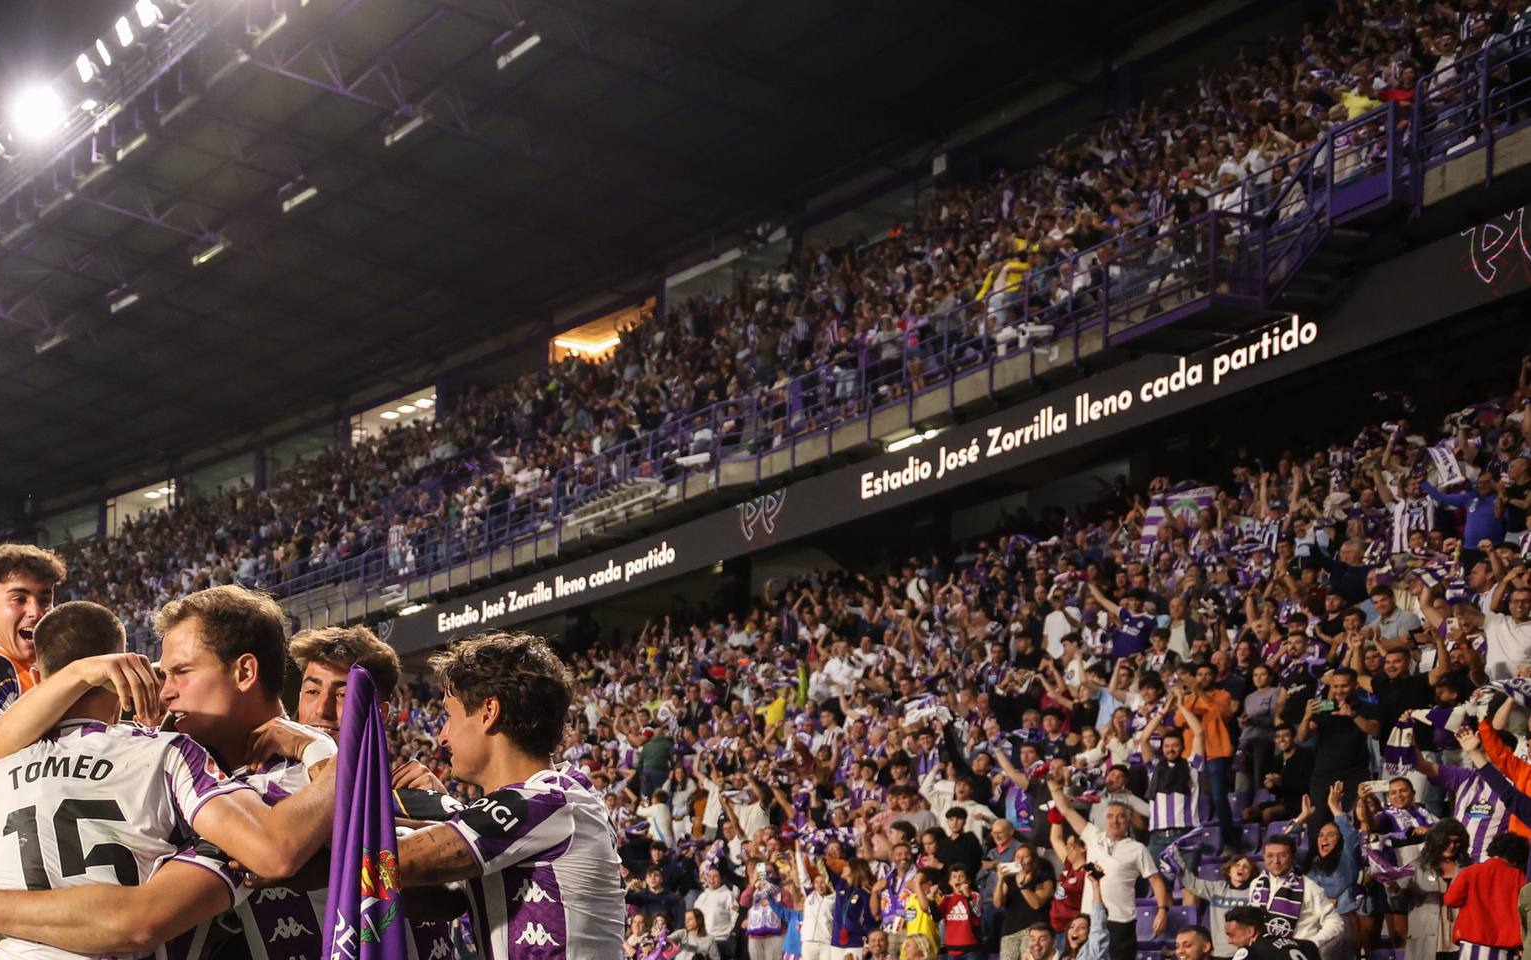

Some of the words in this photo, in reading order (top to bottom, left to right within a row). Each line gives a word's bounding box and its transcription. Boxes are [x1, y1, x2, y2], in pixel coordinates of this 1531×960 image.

[861, 456, 932, 499] Estadio
[936, 438, 980, 479] José
[986, 406, 1068, 458] Zorrilla
[1075, 392, 1133, 427] lleno
[1140, 357, 1203, 403] cada
[1213, 313, 1318, 385] partido
[438, 605, 480, 632] Estadio
[480, 597, 505, 623] José
[507, 581, 552, 613] Zorrilla
[555, 575, 586, 598] lleno
[588, 560, 622, 588] cada
[625, 542, 676, 581] partido
[8, 754, 114, 790] TOMEO
[469, 798, 519, 832] DIGI
